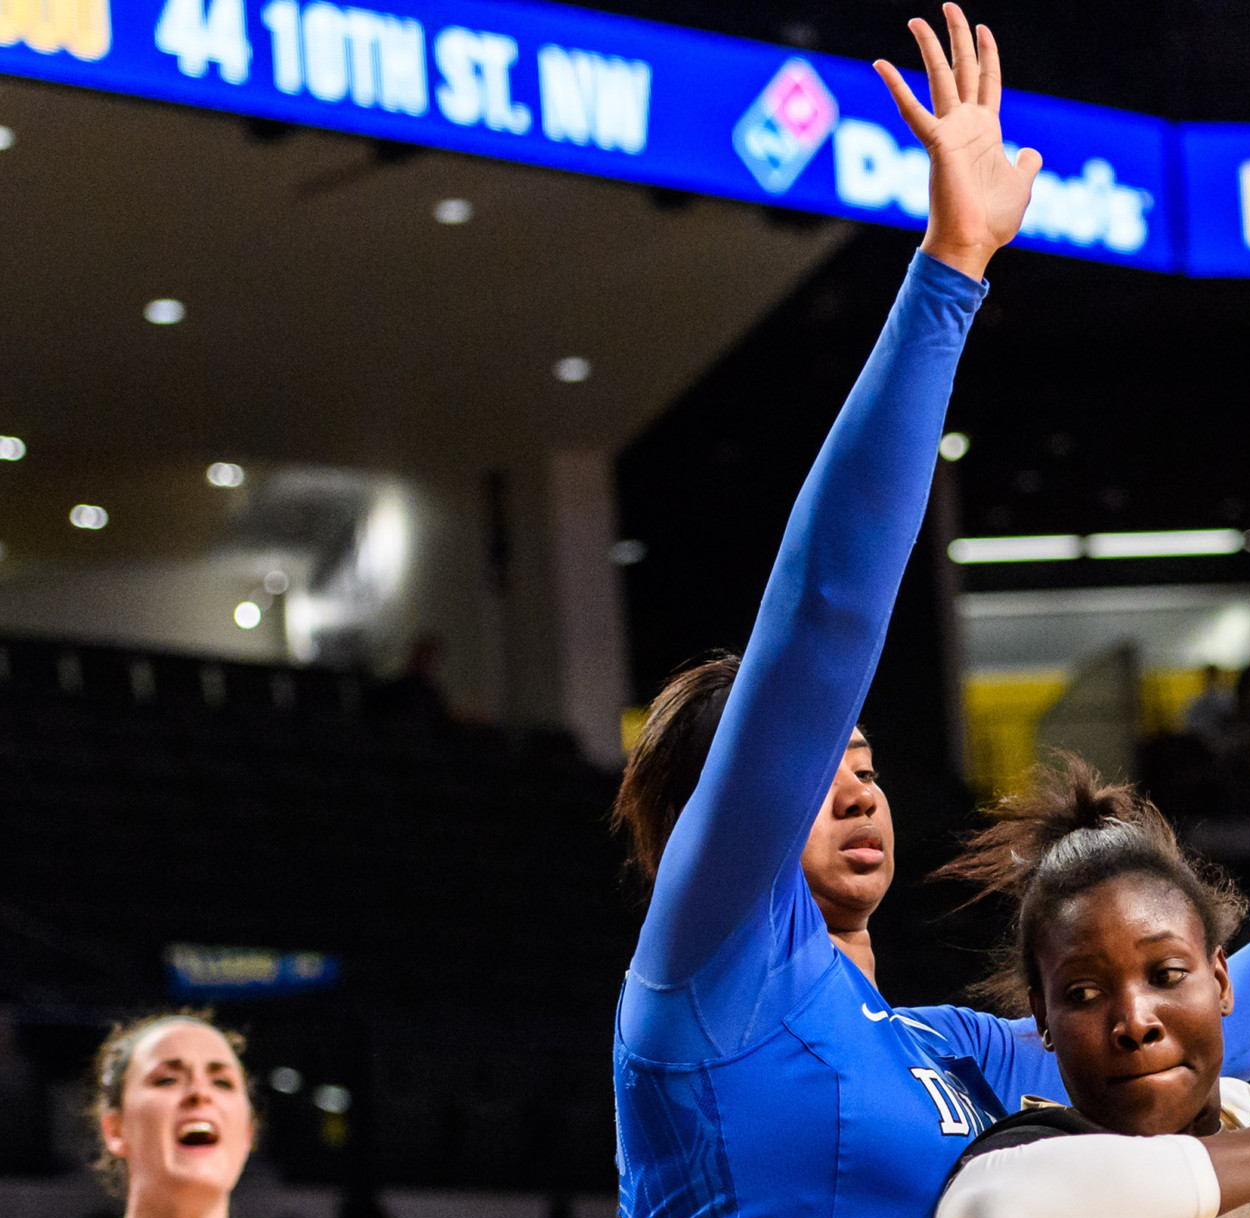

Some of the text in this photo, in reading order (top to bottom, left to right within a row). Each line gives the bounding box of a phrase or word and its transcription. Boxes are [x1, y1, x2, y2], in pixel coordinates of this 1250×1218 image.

[154, 0, 252, 86] 44
[261, 0, 429, 118] 10TH
[435, 26, 532, 135] ST.
[538, 44, 651, 154] NW
